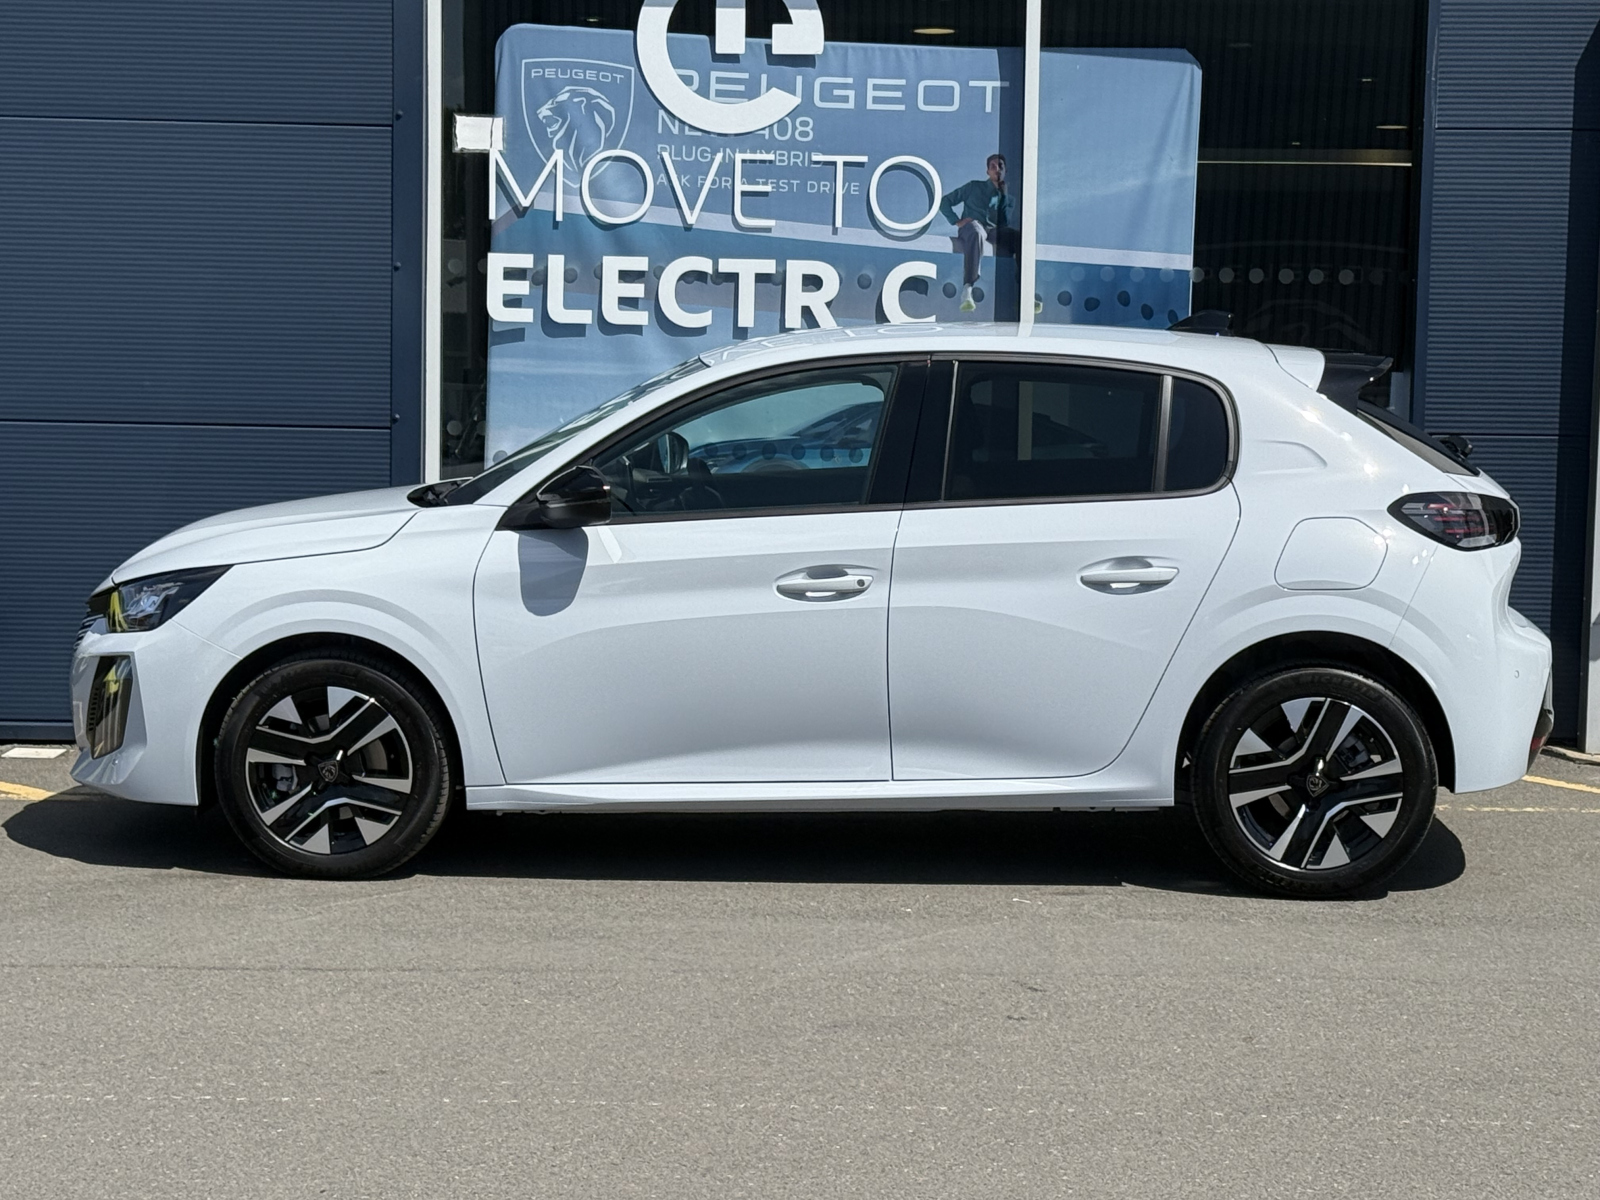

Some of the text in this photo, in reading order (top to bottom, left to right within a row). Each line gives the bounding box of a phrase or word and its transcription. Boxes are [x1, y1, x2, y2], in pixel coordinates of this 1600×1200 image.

[531, 68, 624, 84] PEUGEOT
[656, 173, 691, 188] AK
[488, 148, 943, 231] MOVE TO
